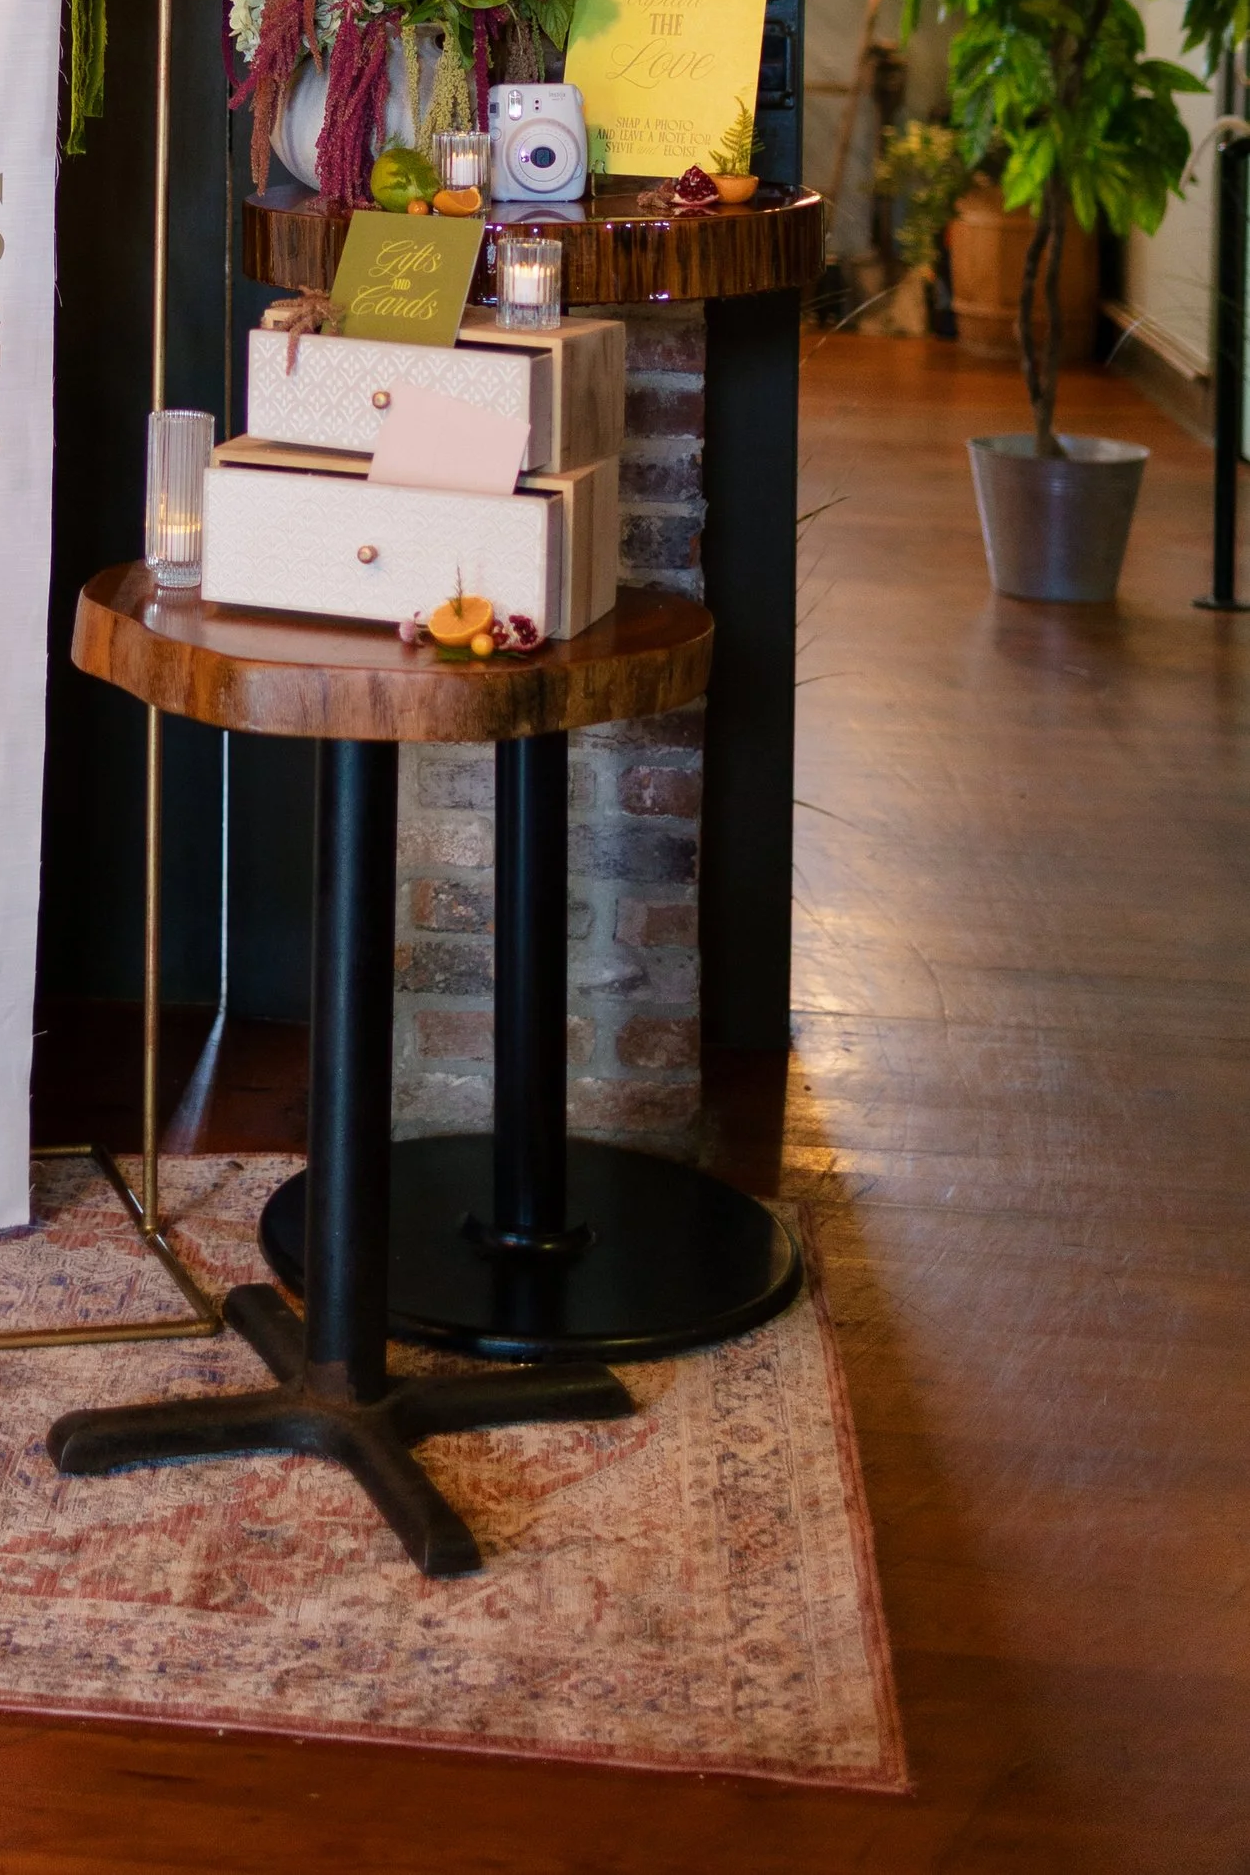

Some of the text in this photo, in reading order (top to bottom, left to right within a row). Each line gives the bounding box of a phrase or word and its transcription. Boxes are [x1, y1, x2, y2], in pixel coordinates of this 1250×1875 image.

[650, 13, 684, 36] THE
[605, 38, 716, 89] Love
[616, 117, 694, 132] SNAP A PHOTO
[596, 128, 711, 145] AND LEAVE A NOTE FOR
[605, 141, 634, 154] SYLVIE
[663, 145, 698, 157] ELOISE
[368, 240, 444, 280] Gifts
[391, 278, 411, 291] AND
[351, 285, 441, 320] Cards
